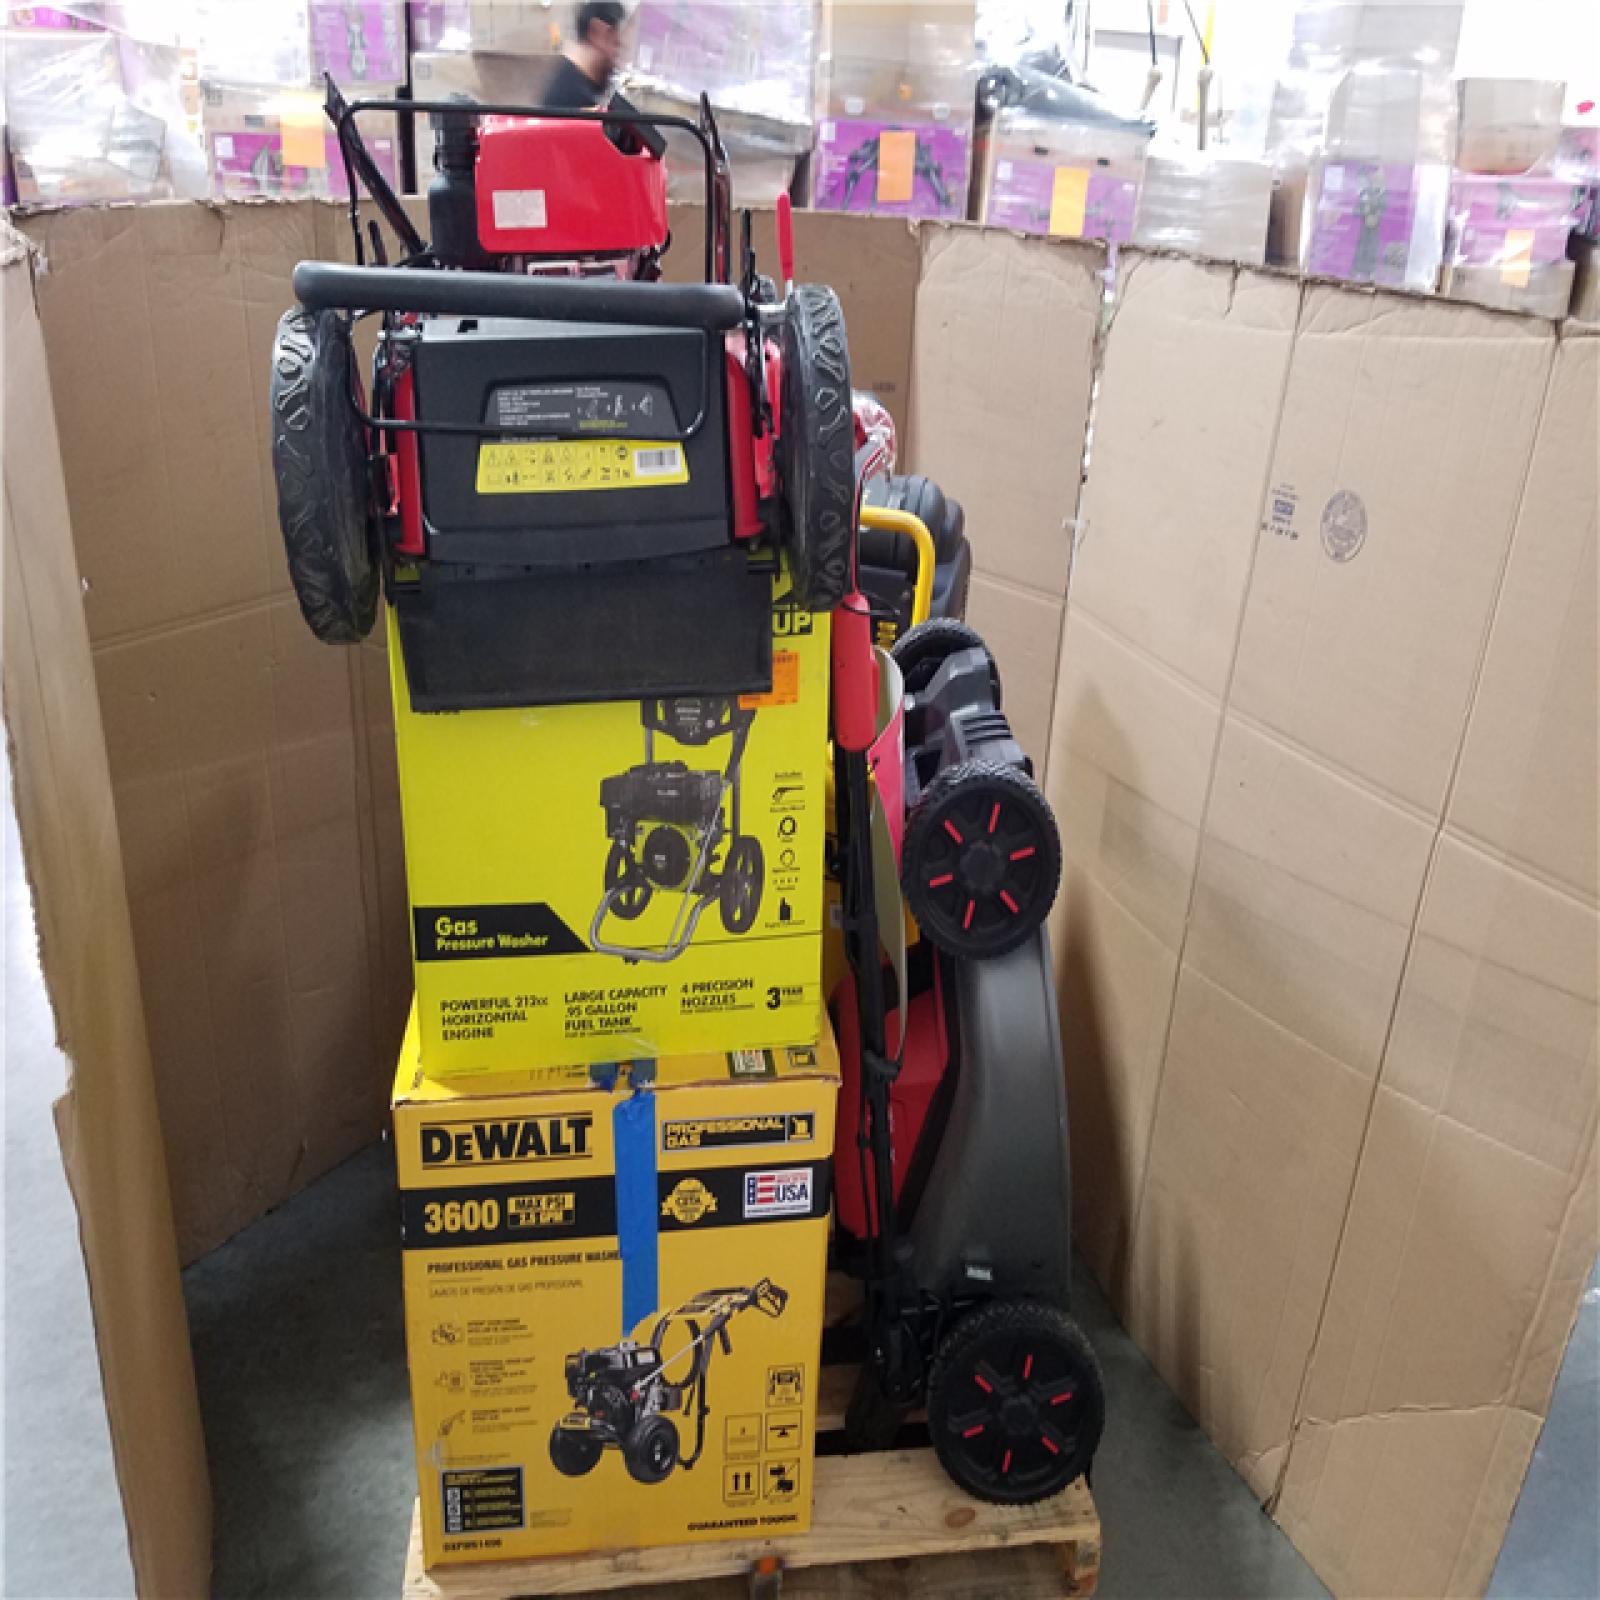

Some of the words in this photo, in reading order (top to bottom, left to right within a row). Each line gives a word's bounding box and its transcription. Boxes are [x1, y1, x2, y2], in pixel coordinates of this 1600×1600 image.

[772, 605, 812, 635] UP
[435, 916, 478, 937] Gas
[436, 936, 495, 951] Pressure
[497, 932, 548, 947] Washer
[564, 989, 605, 1004] LARGE
[609, 984, 668, 1001] CAPACITY
[681, 983, 688, 994] 4
[692, 977, 754, 992] PRECISION
[440, 998, 511, 1012] POWERFUL
[681, 993, 736, 1008] NOZZLES
[766, 987, 781, 1010] 3
[441, 1010, 528, 1027] HORIZONTAL
[585, 1002, 637, 1016] GALLON
[564, 1019, 594, 1030] FUEL
[599, 1016, 632, 1028] TANK
[441, 1027, 494, 1041] ENGINE
[665, 1116, 786, 1136] PROFESSIONAL
[421, 1117, 593, 1163] DEWALT
[774, 1182, 809, 1204] USA
[423, 1198, 500, 1234] 3600
[427, 1259, 503, 1274] PROFESSIONAL
[507, 1255, 528, 1269] GAS
[530, 1253, 582, 1268] PRESSURE
[688, 1516, 758, 1531] GUARANTEED
